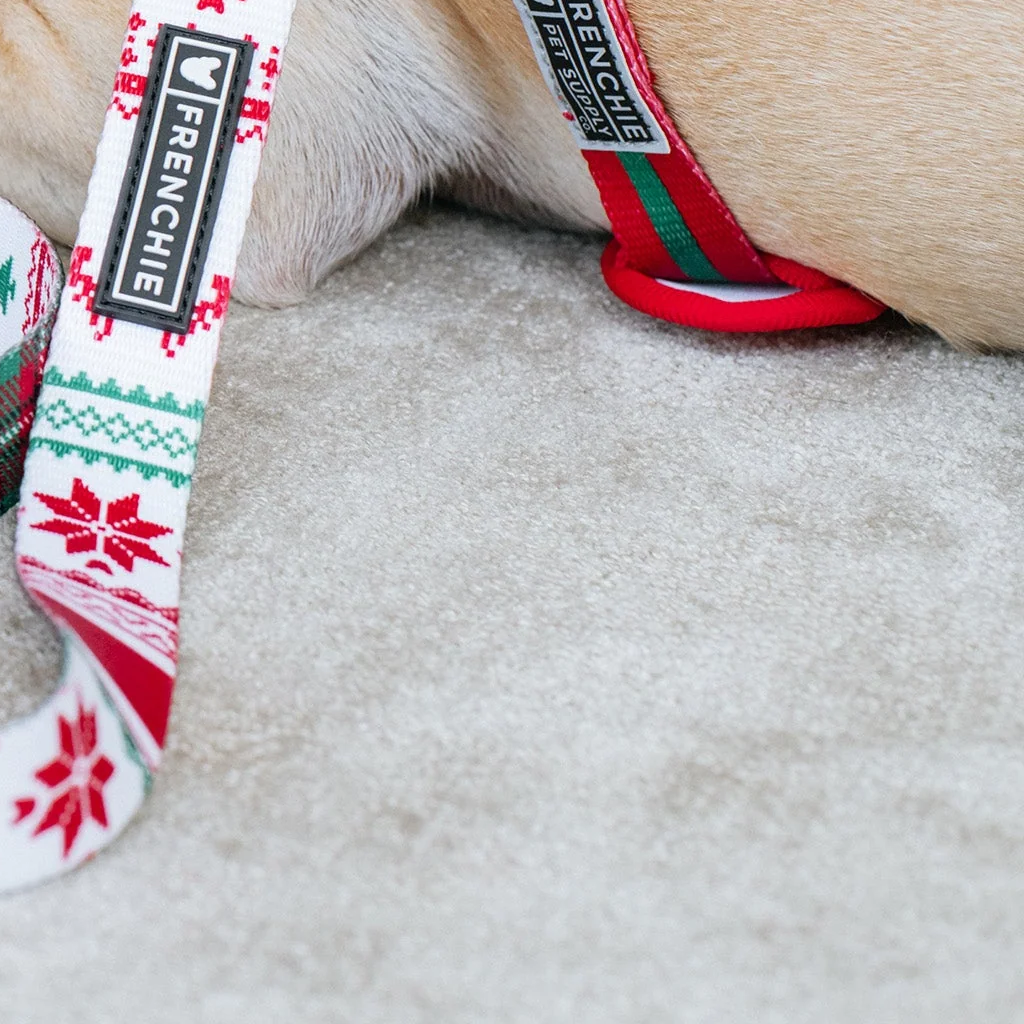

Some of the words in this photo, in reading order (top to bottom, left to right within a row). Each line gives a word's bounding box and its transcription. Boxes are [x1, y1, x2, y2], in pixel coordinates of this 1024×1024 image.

[542, 24, 569, 61] PET
[563, 67, 613, 137] SUPPLY
[133, 102, 204, 297] FRENCHIE
